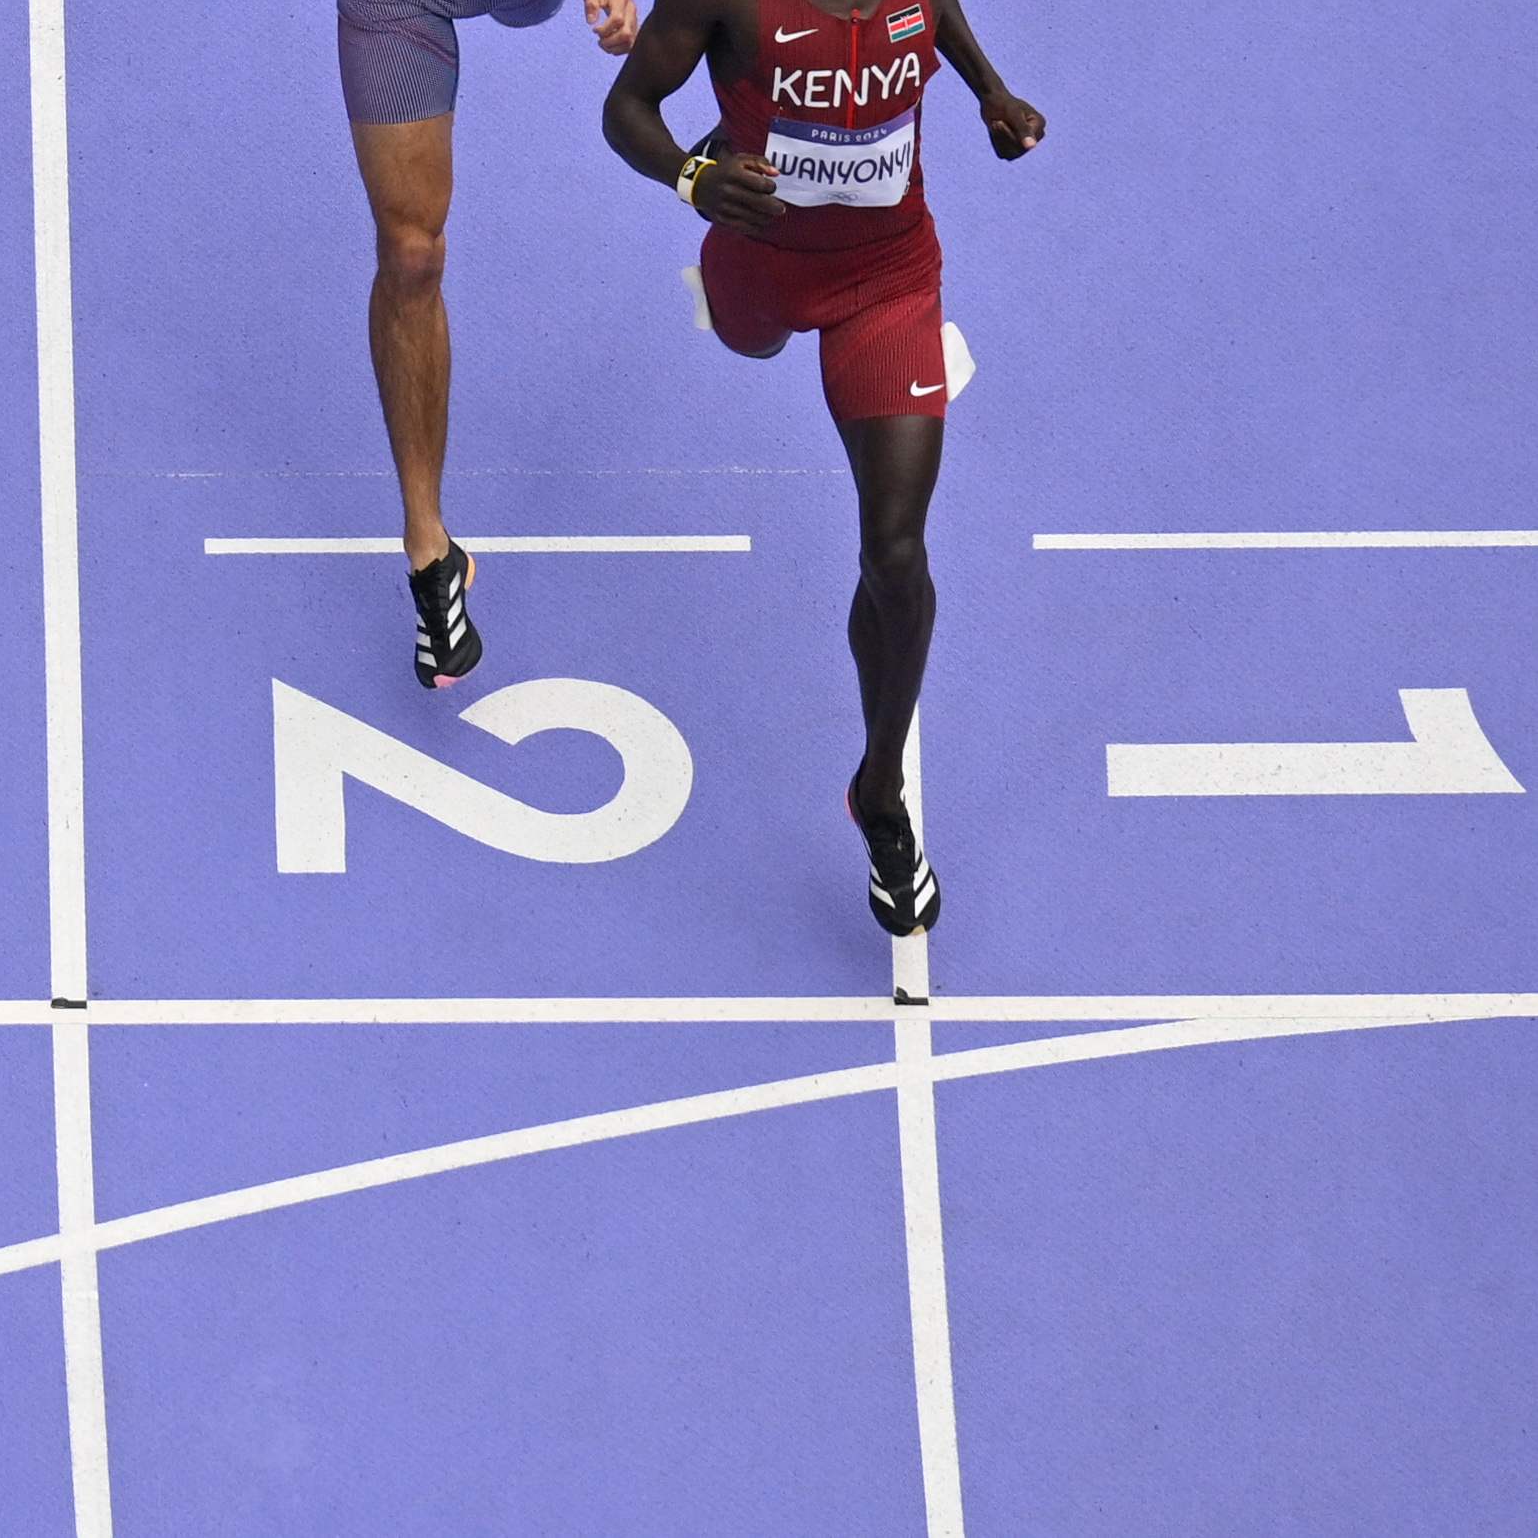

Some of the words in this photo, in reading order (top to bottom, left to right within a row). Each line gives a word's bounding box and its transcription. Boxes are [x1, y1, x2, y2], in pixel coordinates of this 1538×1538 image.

[771, 51, 921, 108] KENYA
[771, 140, 911, 185] WANYONYI
[811, 128, 851, 143] PARIS
[855, 127, 888, 142] 2024
[1104, 686, 1527, 798] 1
[270, 676, 694, 875] 2
